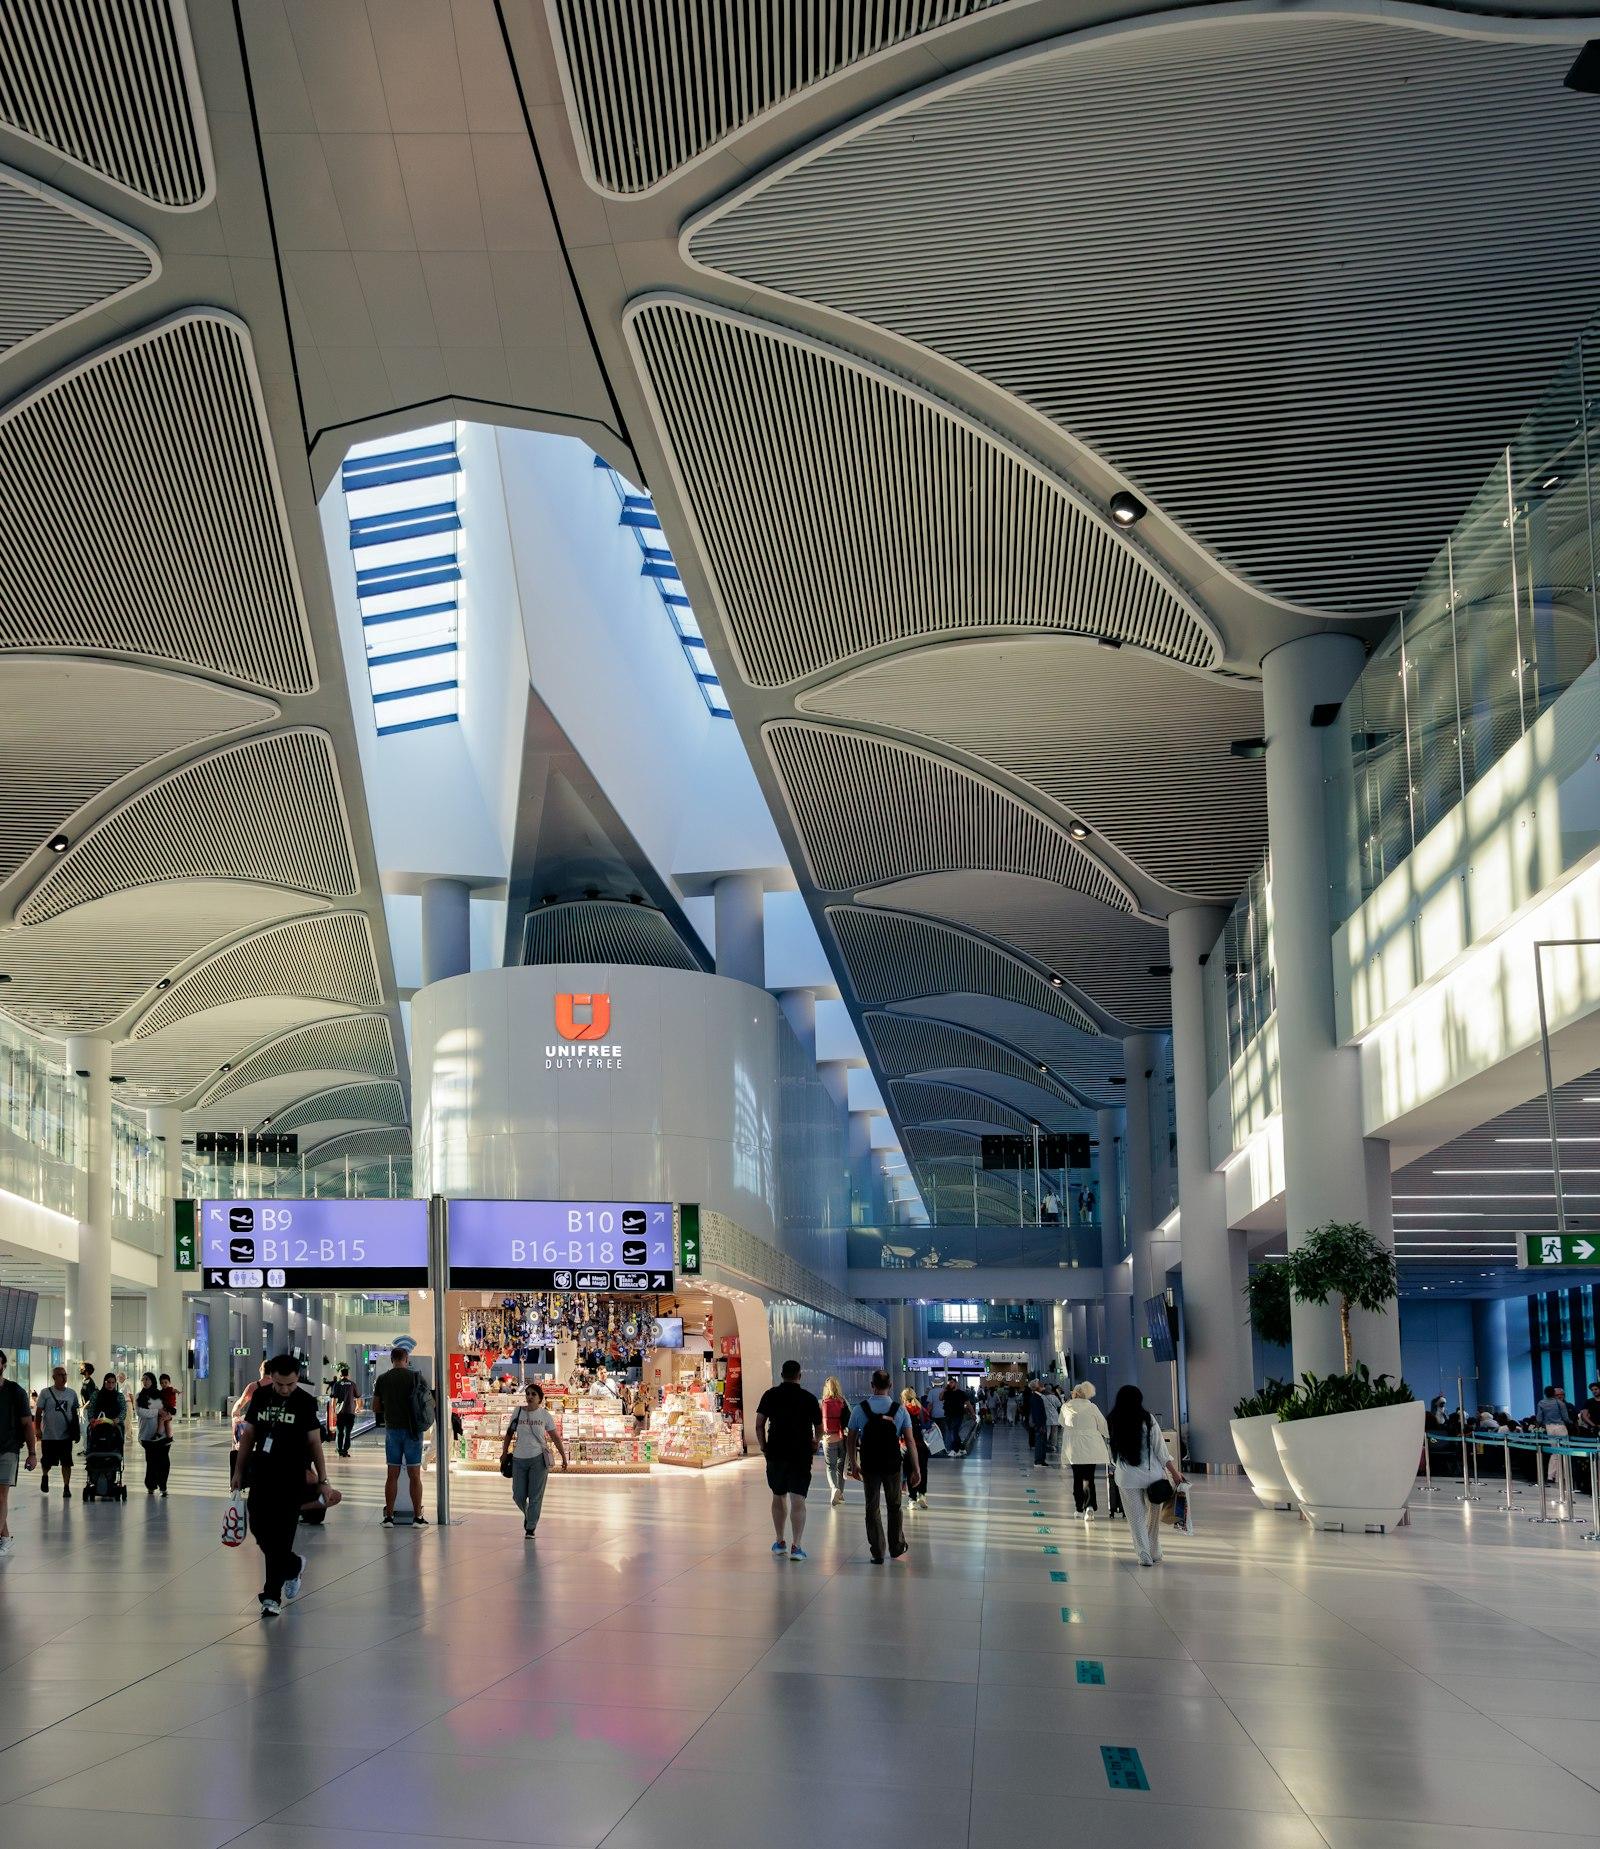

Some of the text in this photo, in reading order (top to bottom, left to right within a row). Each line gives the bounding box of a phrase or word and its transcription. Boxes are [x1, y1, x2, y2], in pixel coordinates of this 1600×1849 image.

[545, 1045, 622, 1057] UNIFREE
[545, 1059, 623, 1069] DUTYFREE
[262, 1208, 293, 1231] B9
[568, 1210, 614, 1233] B10
[263, 1239, 366, 1262] B12-B15
[511, 1240, 614, 1264] B16-B18
